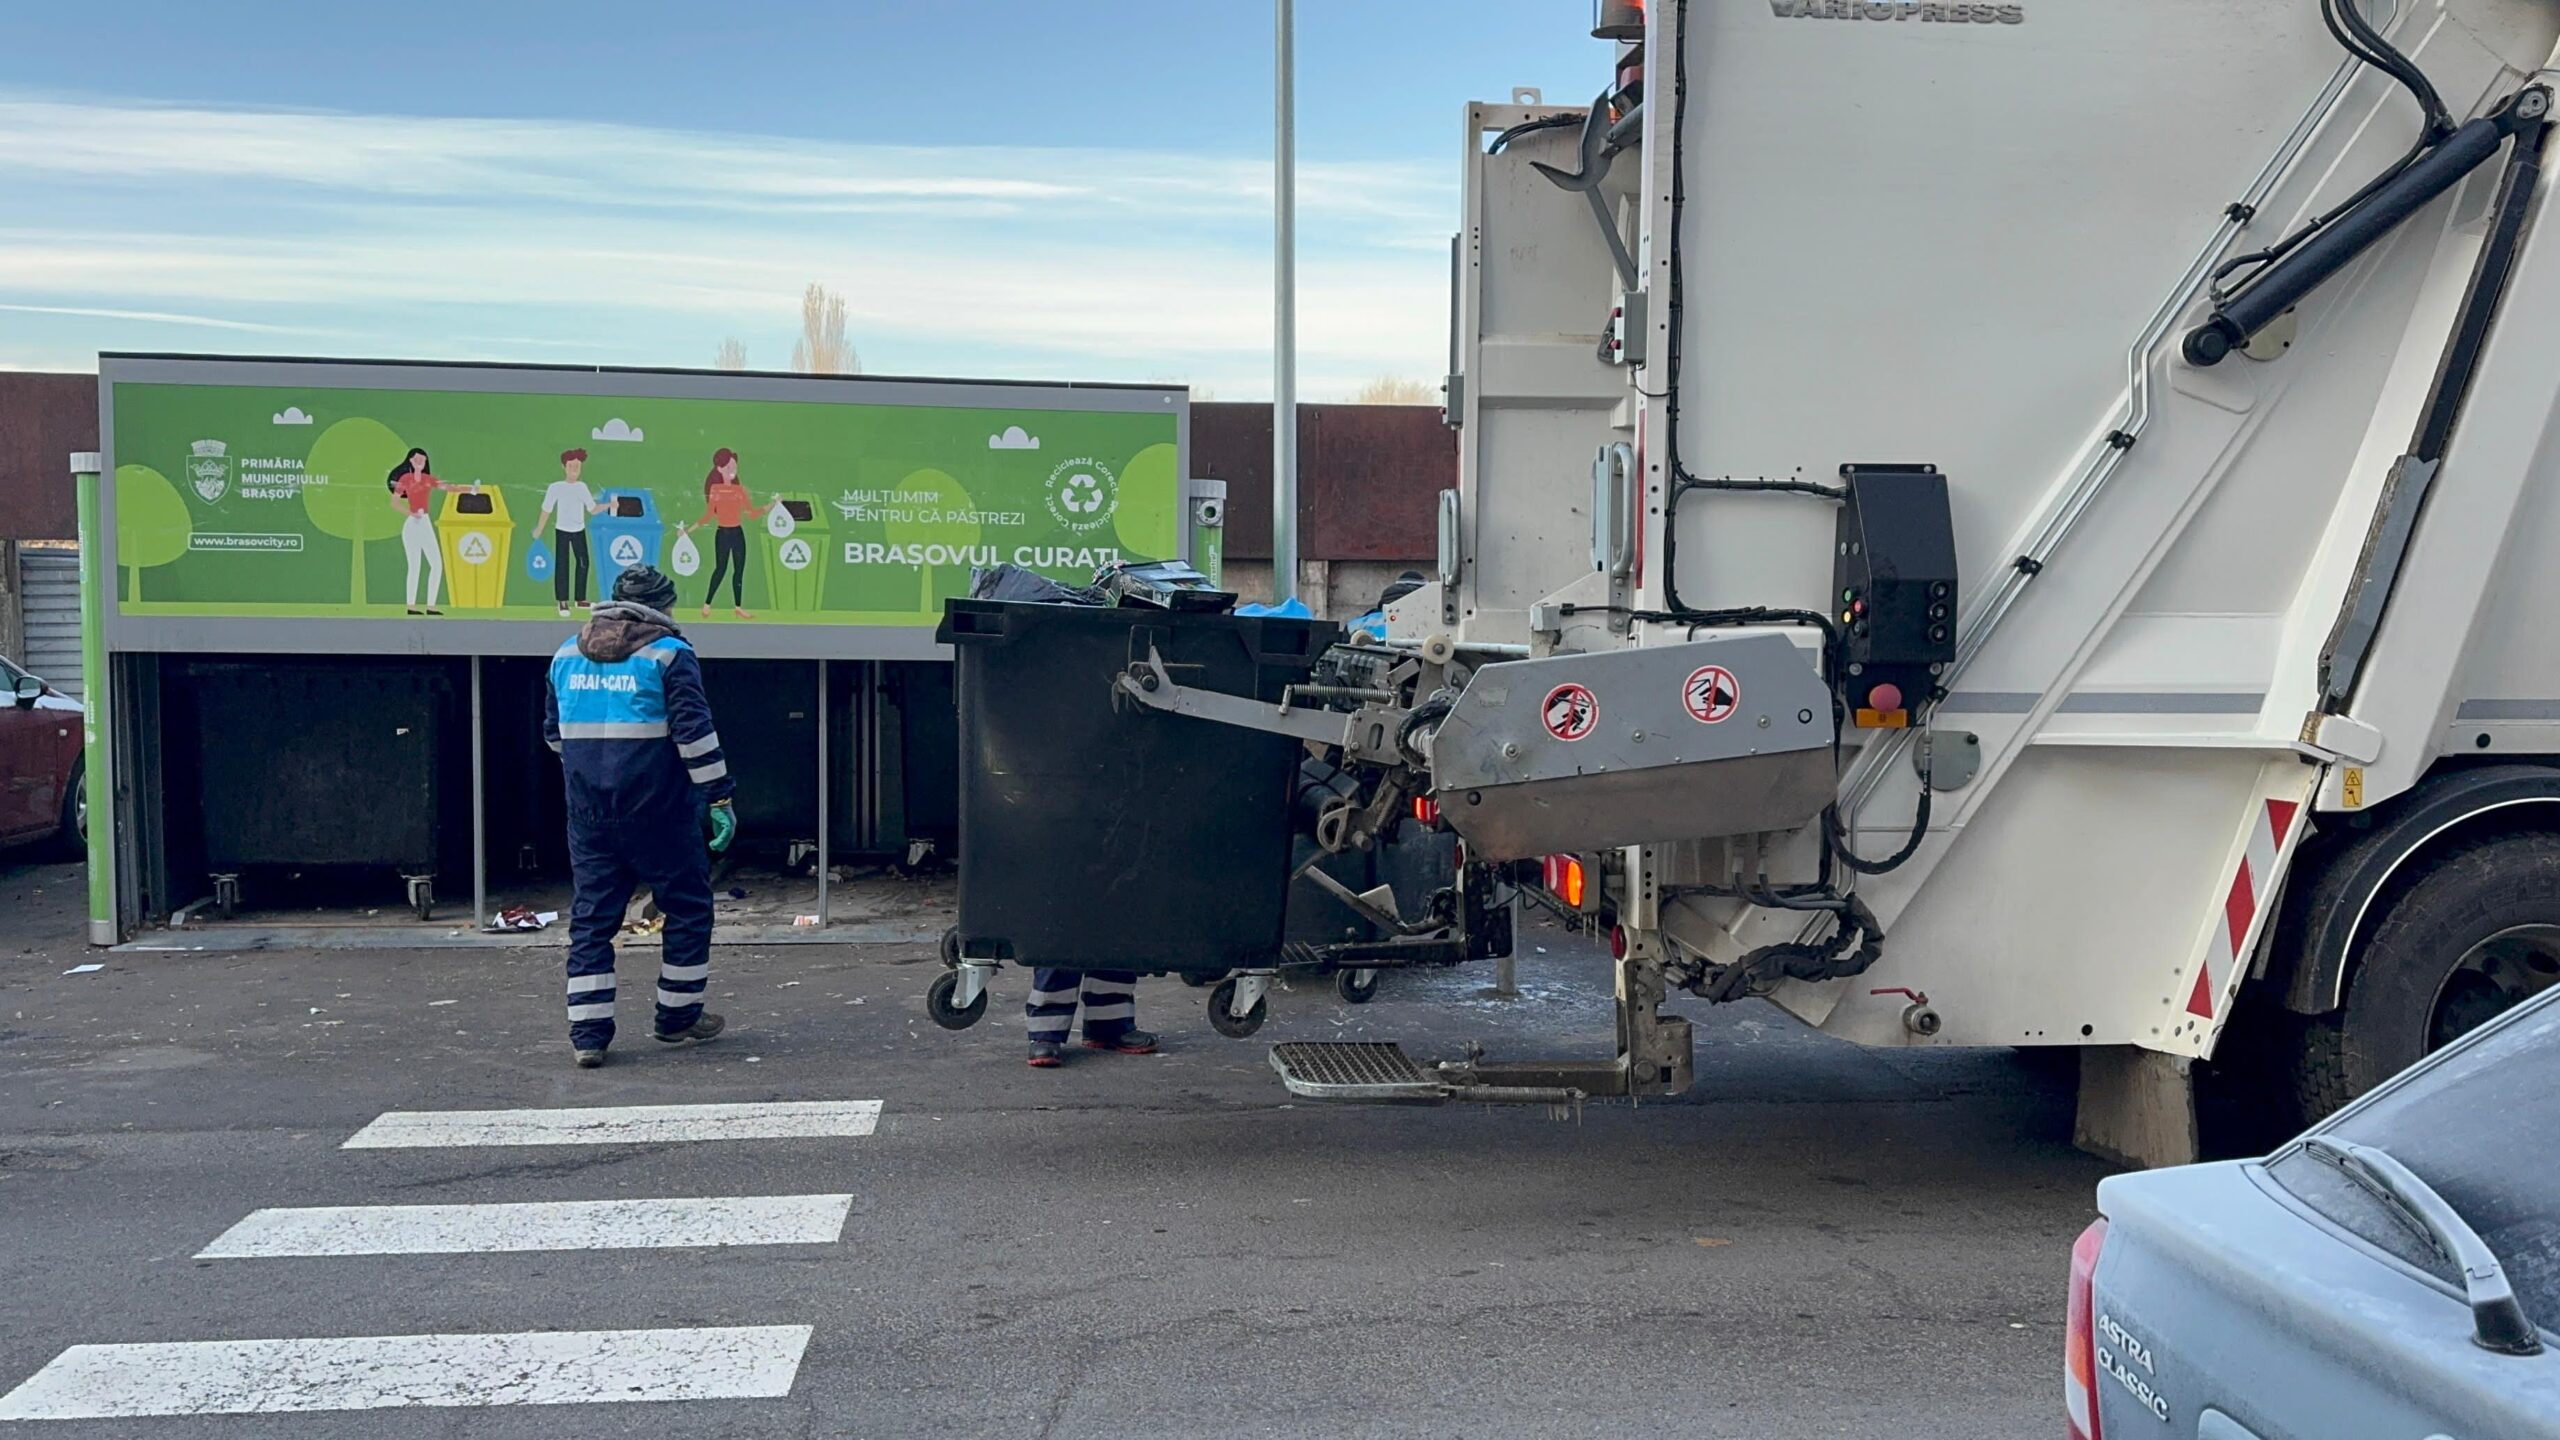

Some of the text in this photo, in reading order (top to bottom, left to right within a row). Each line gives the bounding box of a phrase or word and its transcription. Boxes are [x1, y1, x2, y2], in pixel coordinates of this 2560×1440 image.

[1770, 0, 2024, 25] VARIOPRESS
[241, 456, 304, 469] PRIMĂRIA
[241, 473, 329, 485] MUNICIPIULUI
[1095, 461, 1119, 495] Corect
[241, 488, 293, 501] BRAȘOV
[844, 489, 938, 506] MULȚUMIM
[844, 508, 1025, 525] PENTRU CĂ PĂSTREZI
[1045, 493, 1069, 528] Corect
[194, 536, 297, 548] www.brasovcity.ro
[844, 542, 1006, 572] BRAȘOVUL
[2099, 1314, 2155, 1376] ASTRA
[2098, 1346, 2170, 1423] CLASSIC
